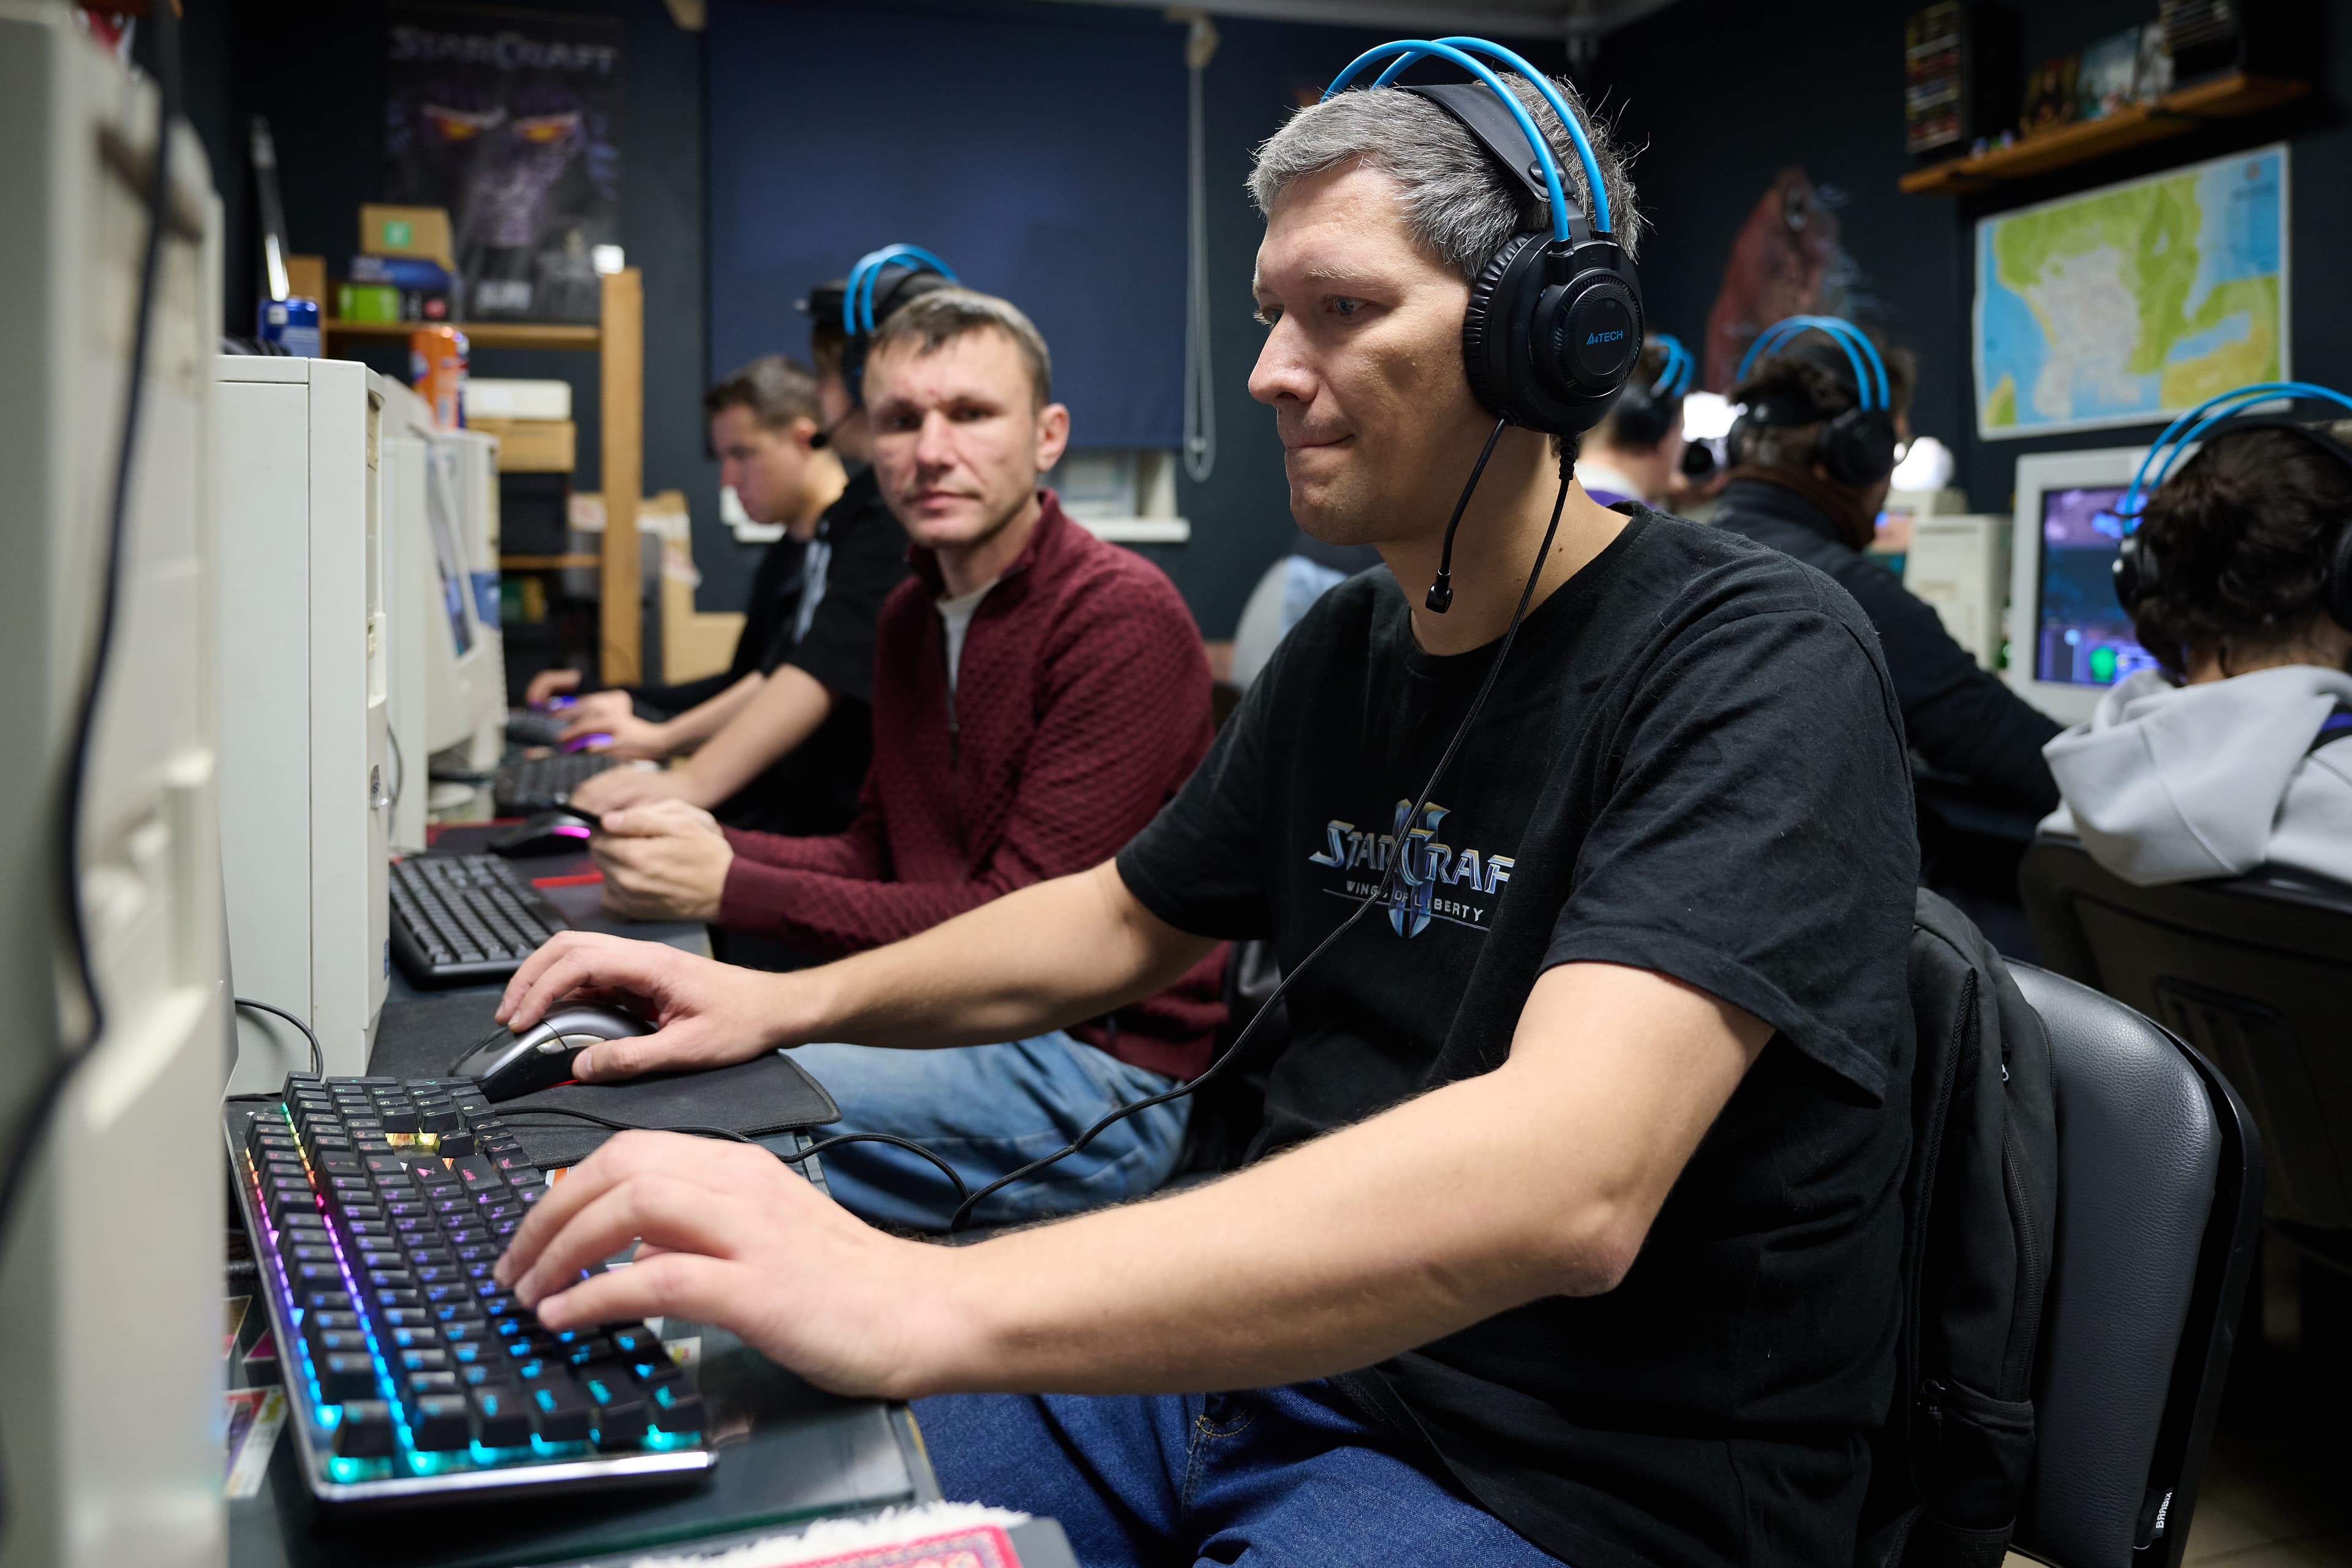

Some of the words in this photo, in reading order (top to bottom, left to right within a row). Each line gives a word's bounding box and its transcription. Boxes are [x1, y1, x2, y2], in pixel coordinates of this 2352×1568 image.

[1586, 330, 1623, 345] A4TECH
[1309, 820, 1515, 894] STARCRAF
[1346, 880, 1388, 899] WING
[1394, 890, 1409, 903] OF
[1414, 894, 1483, 922] LIBERTY
[2155, 1492, 2173, 1529] BRABIX
